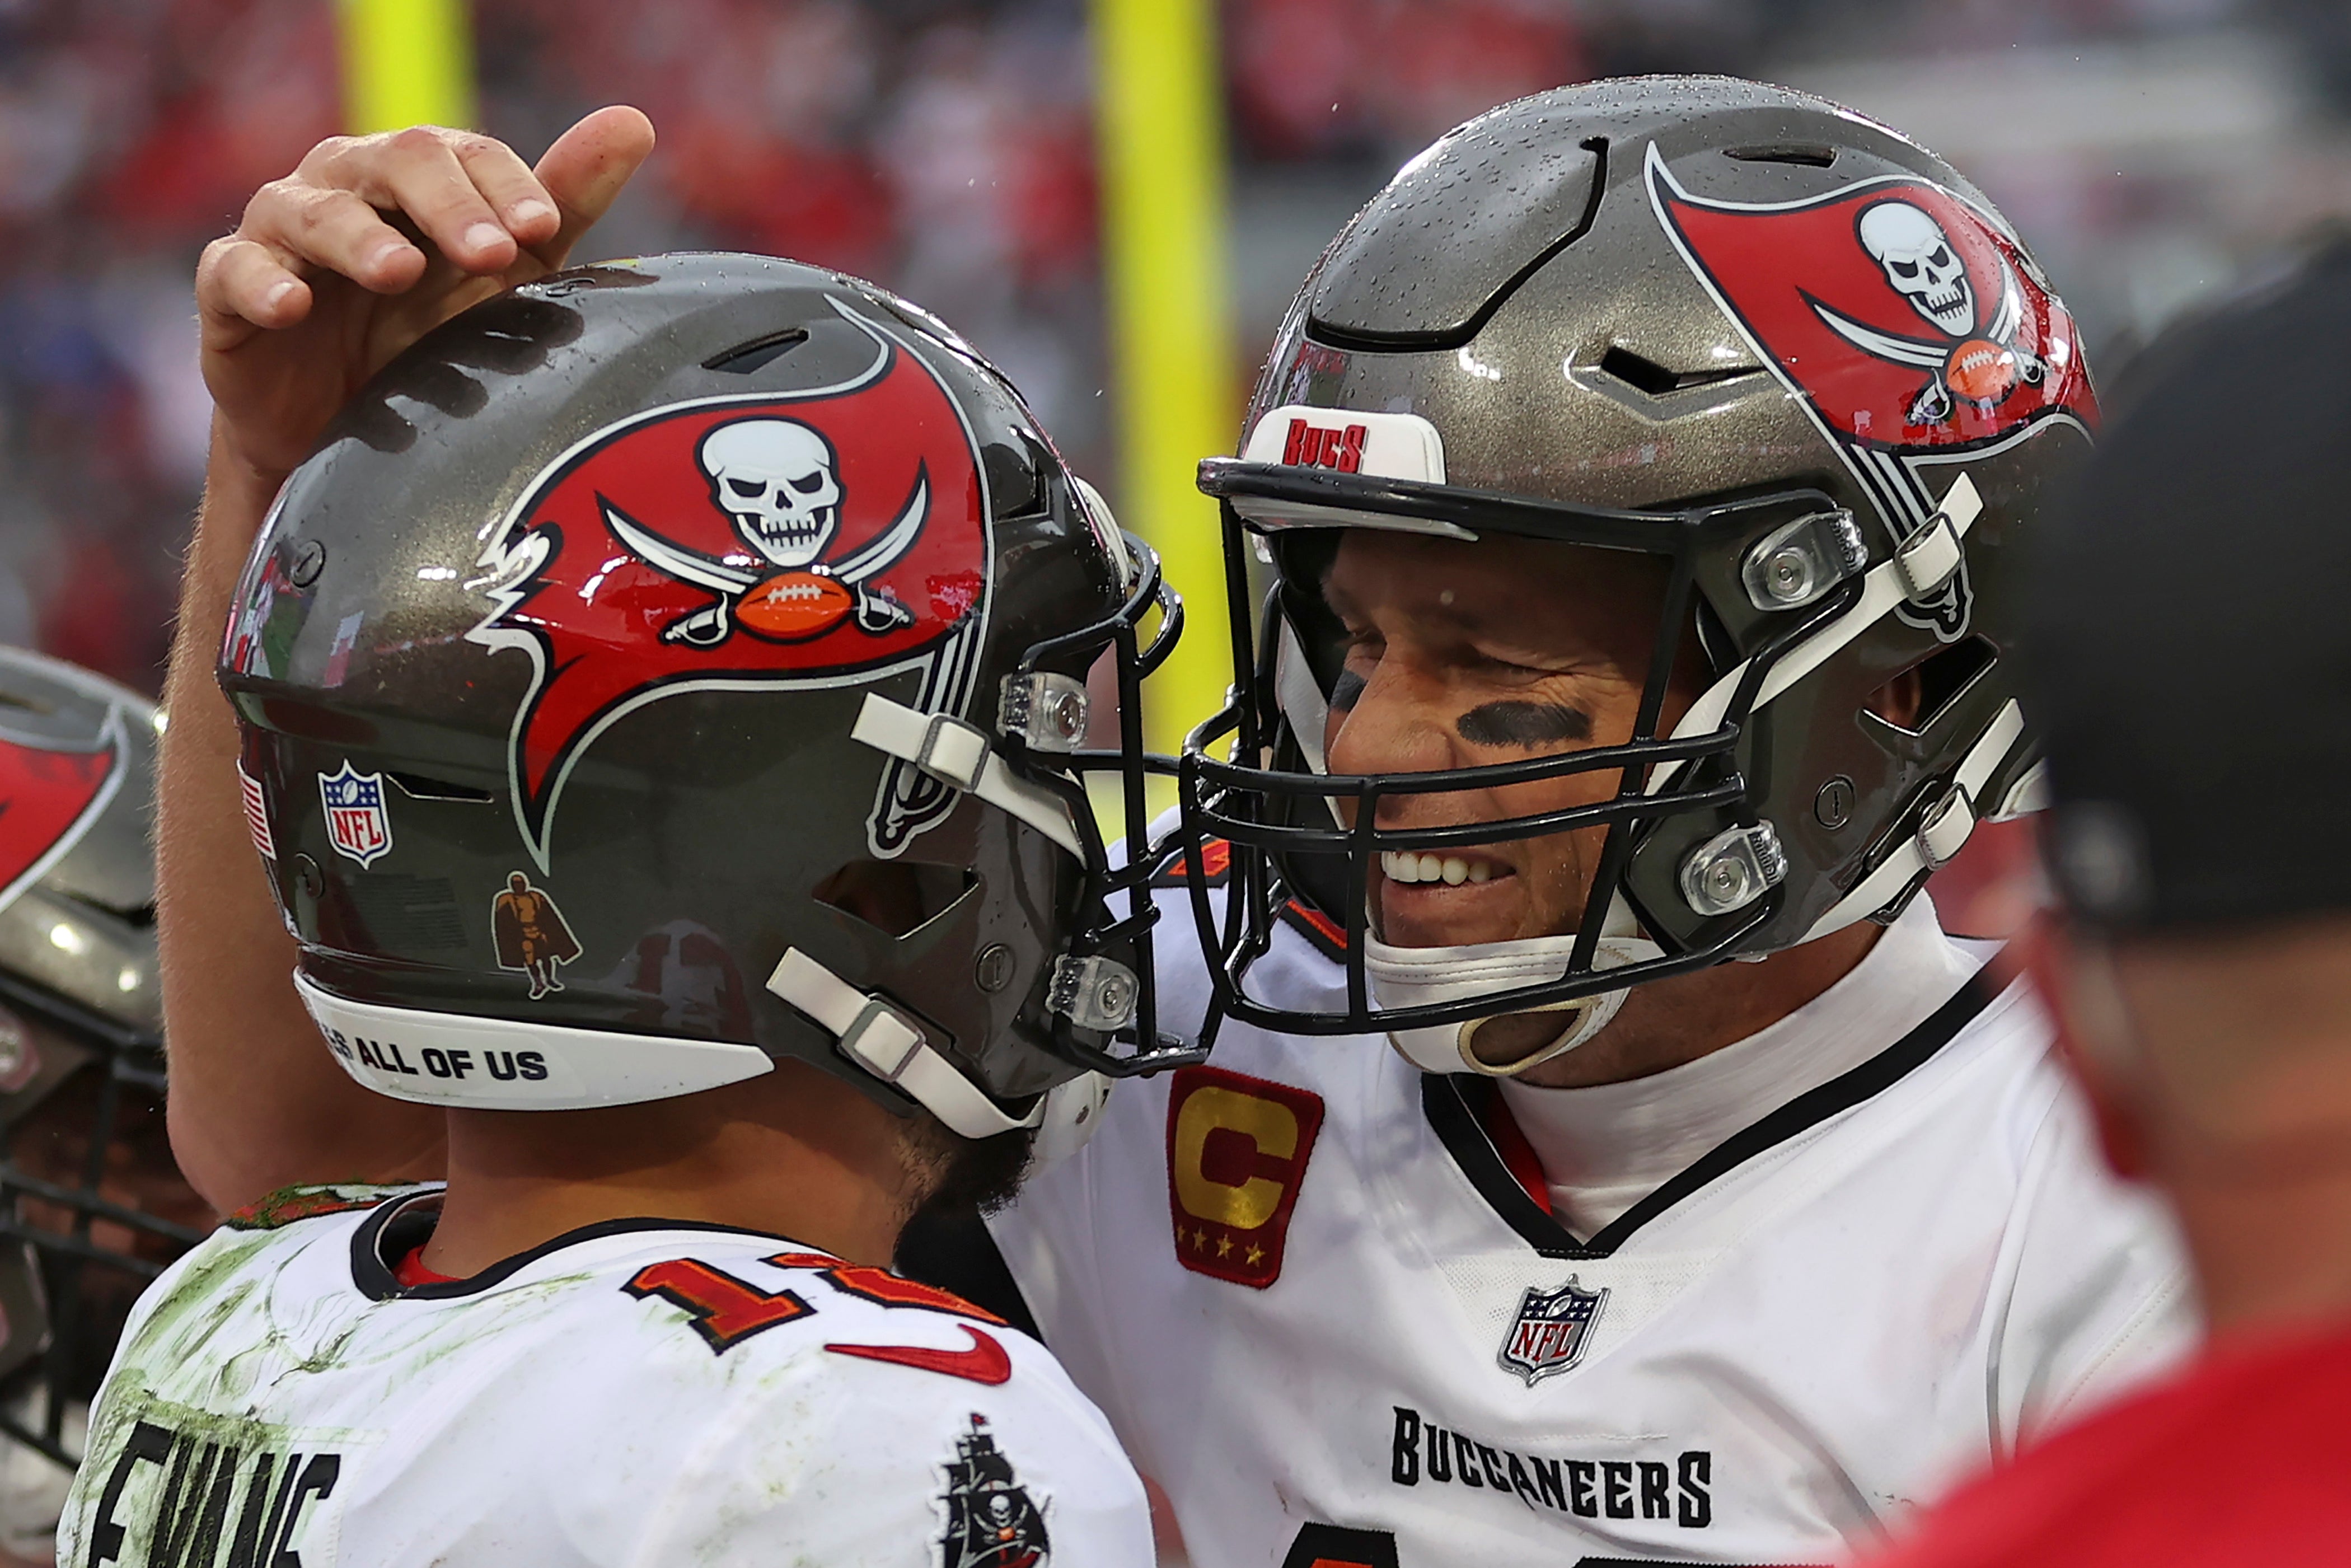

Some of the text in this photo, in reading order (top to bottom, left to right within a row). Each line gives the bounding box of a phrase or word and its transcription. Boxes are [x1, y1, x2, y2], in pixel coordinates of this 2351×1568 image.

[1282, 418, 1367, 474] BUCS
[332, 810, 382, 851] NFL
[355, 1037, 419, 1075] ALL
[421, 1048, 475, 1080] OF
[487, 1051, 549, 1081] US
[1174, 1086, 1298, 1229] C
[1511, 1322, 1574, 1362] NFL
[1392, 1406, 1712, 1528] BUCCANEERS
